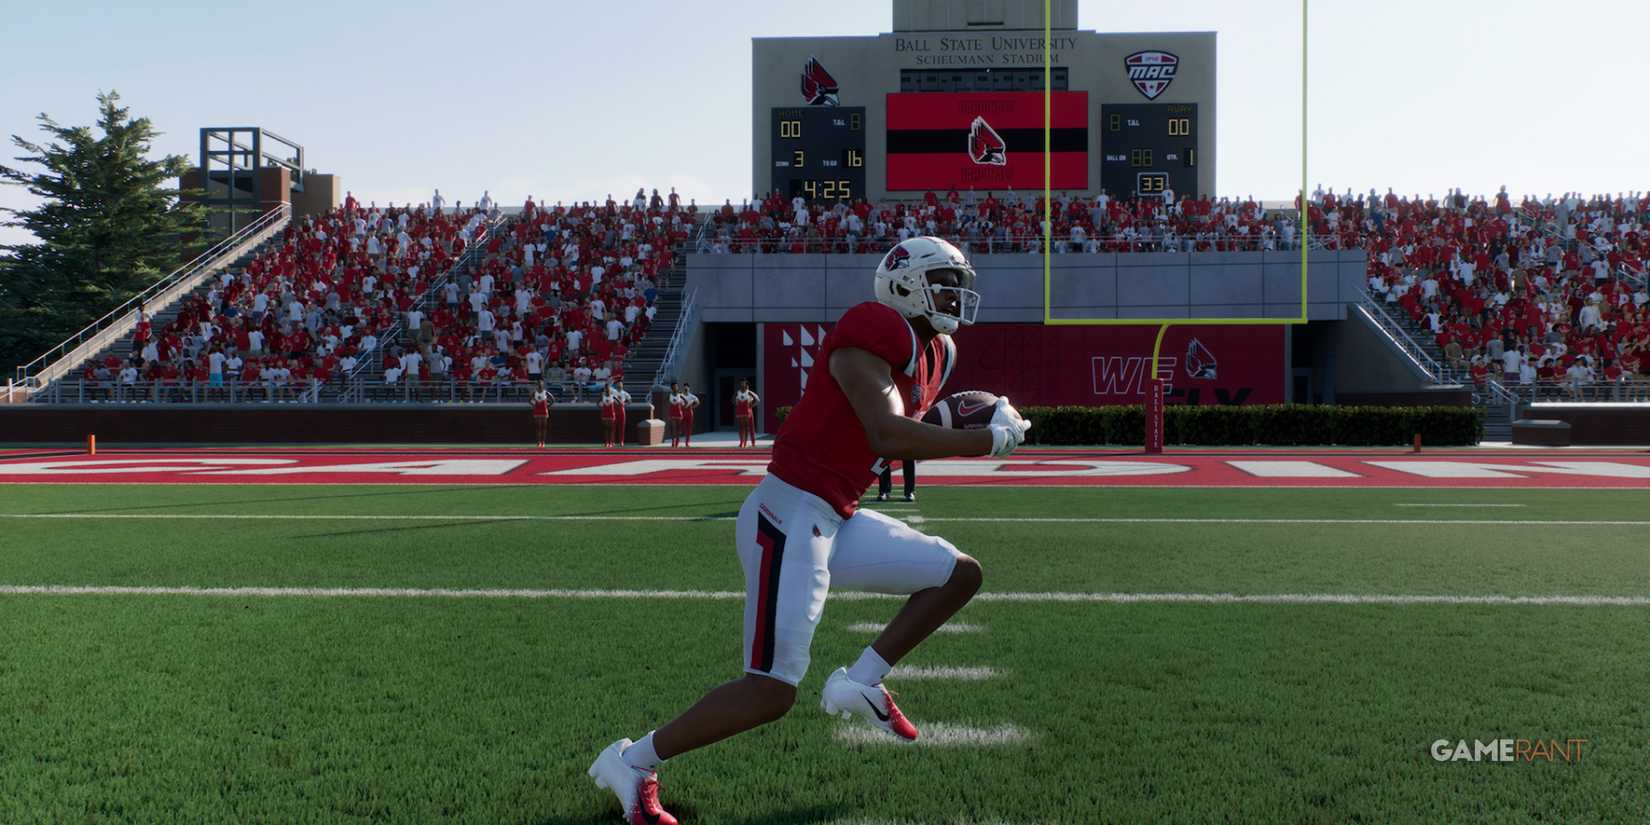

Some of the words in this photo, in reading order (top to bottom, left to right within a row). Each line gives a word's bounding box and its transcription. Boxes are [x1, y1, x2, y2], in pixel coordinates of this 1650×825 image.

[896, 39, 931, 52] BALL
[941, 38, 983, 52] STATE
[916, 55, 994, 65] SCHEUMANN
[1128, 66, 1176, 79] MAC
[781, 121, 801, 138] 00
[1168, 119, 1189, 136] 00
[793, 150, 804, 167] 3
[848, 150, 862, 167] 16
[804, 181, 850, 199] 4:25
[1142, 177, 1164, 191] 33
[1091, 356, 1178, 395] WE
